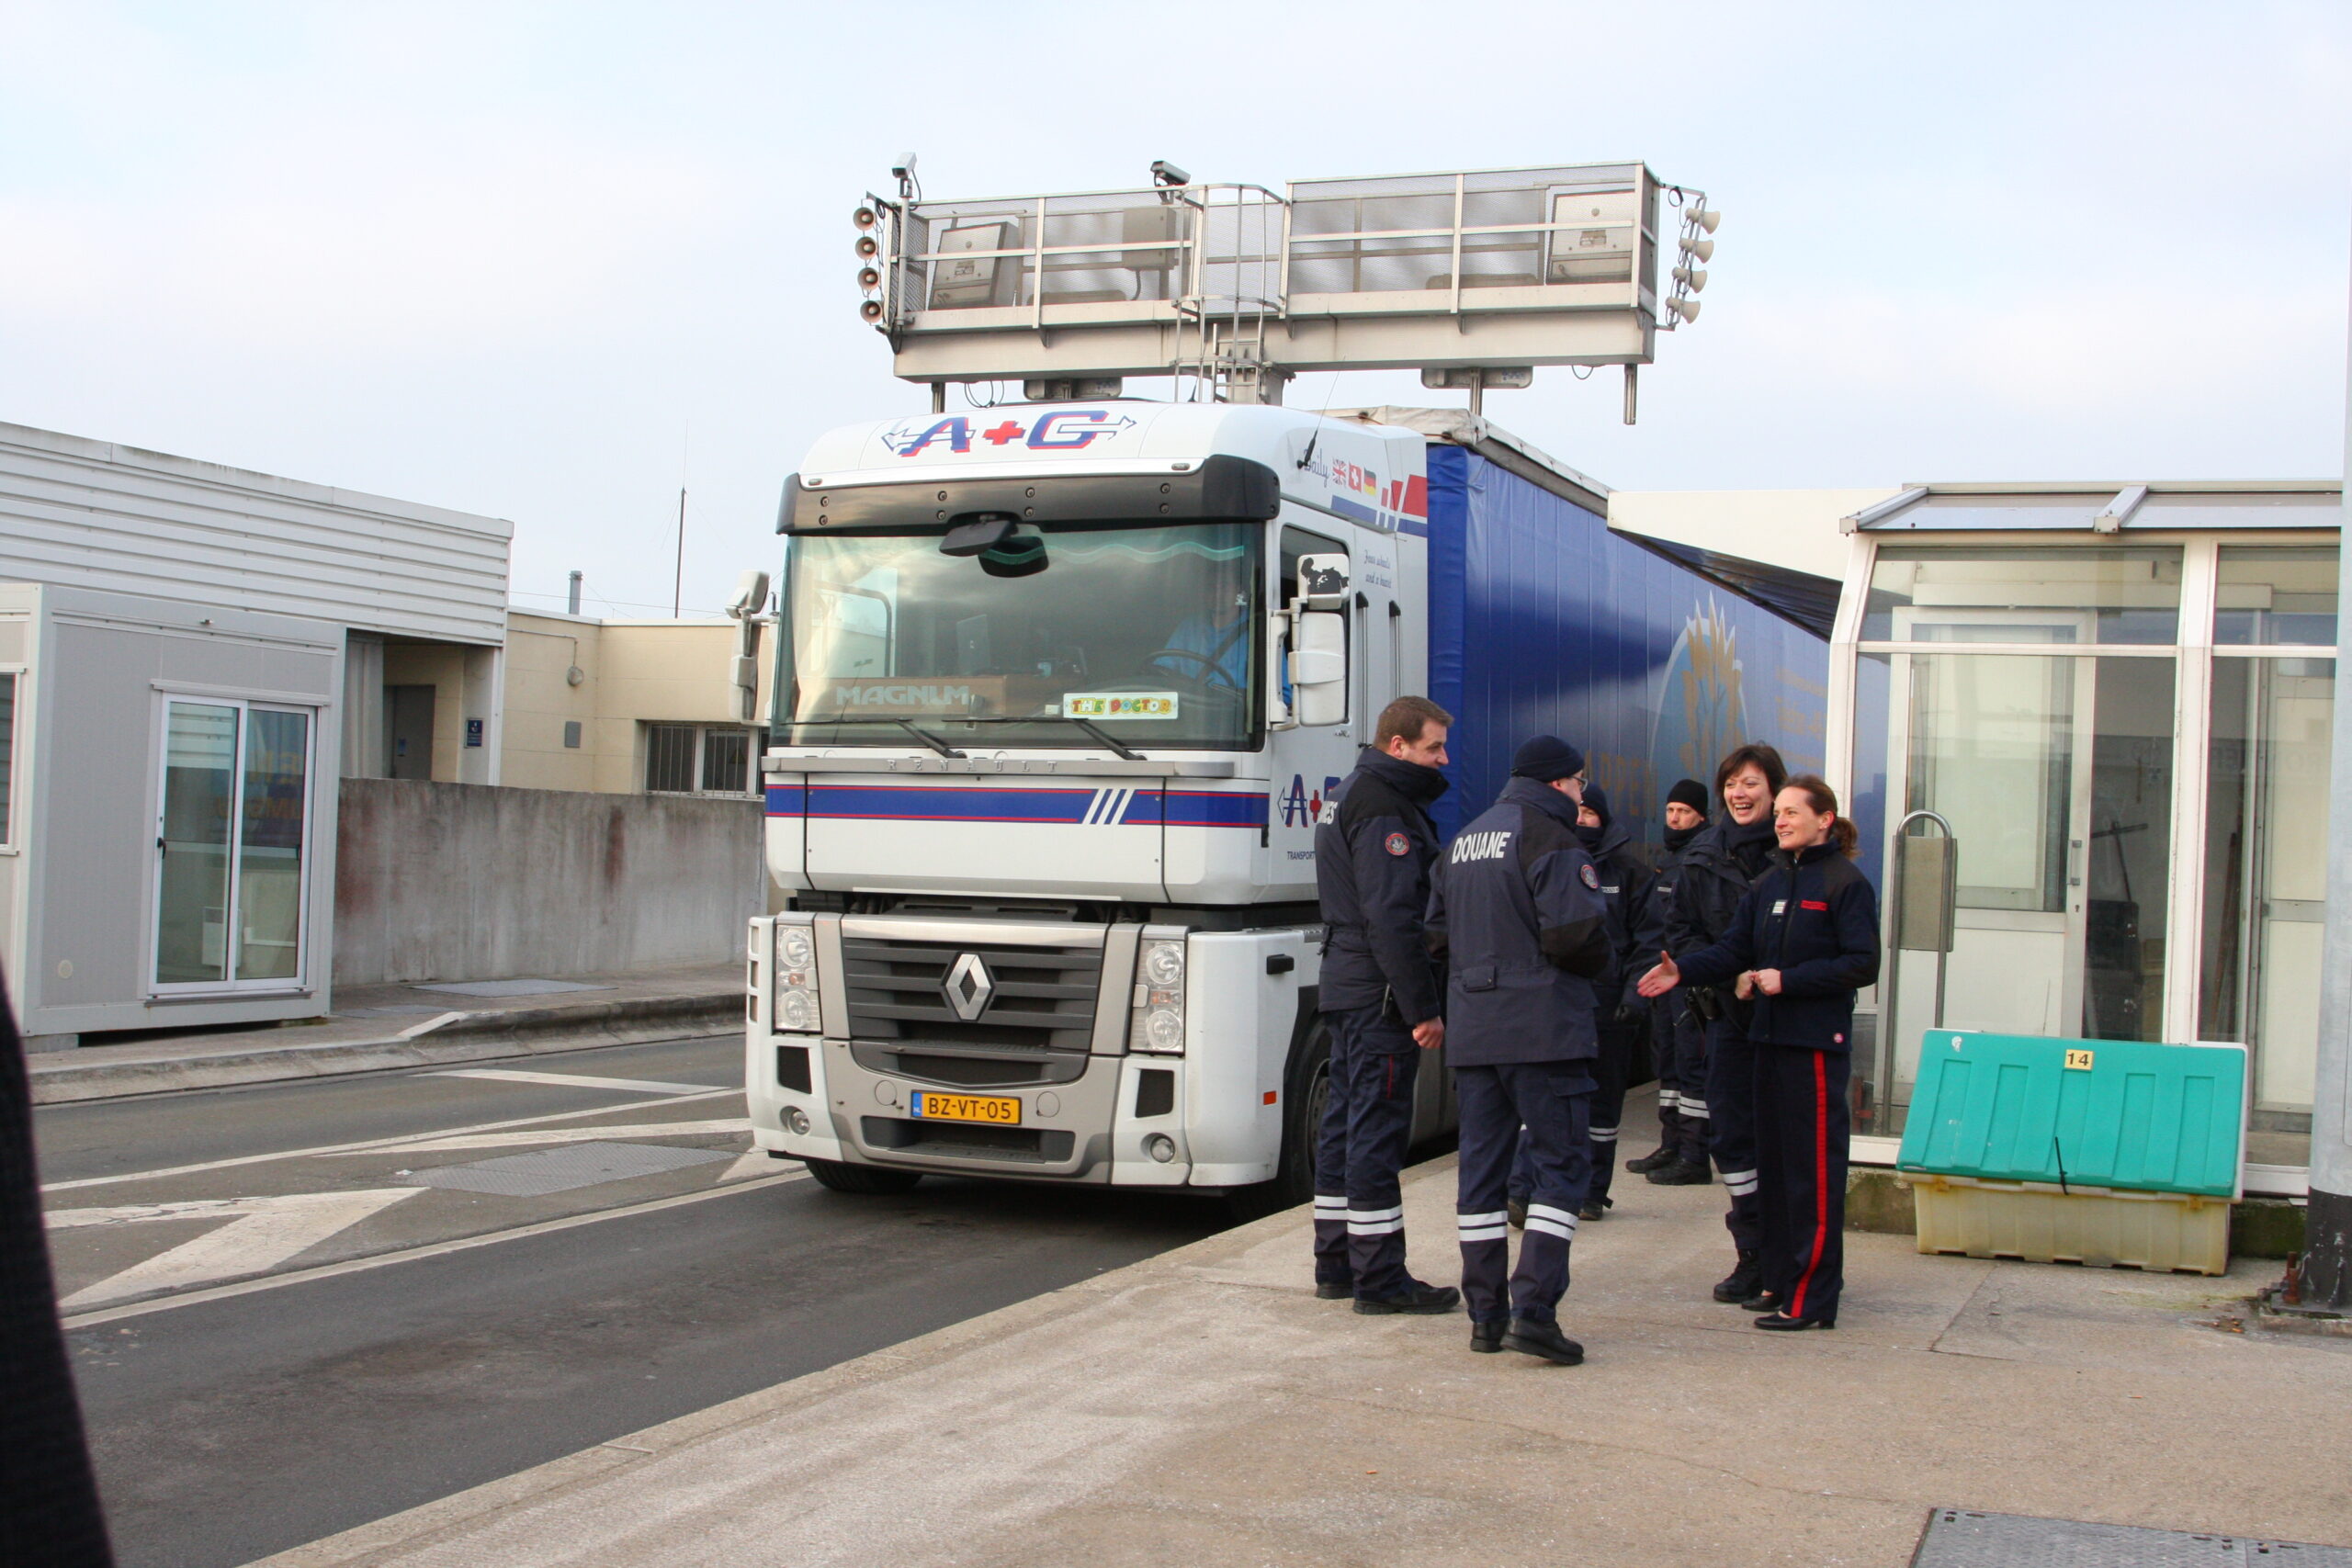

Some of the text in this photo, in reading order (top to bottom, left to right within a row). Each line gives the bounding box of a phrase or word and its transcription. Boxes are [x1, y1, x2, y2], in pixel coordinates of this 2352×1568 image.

[1070, 697, 1171, 715] THE DOCTOR
[887, 759, 1058, 773] RENAULT
[1451, 831, 1511, 864] DOUANE
[2067, 1052, 2089, 1066] 14
[928, 1097, 1012, 1119] BZ-VT-05
